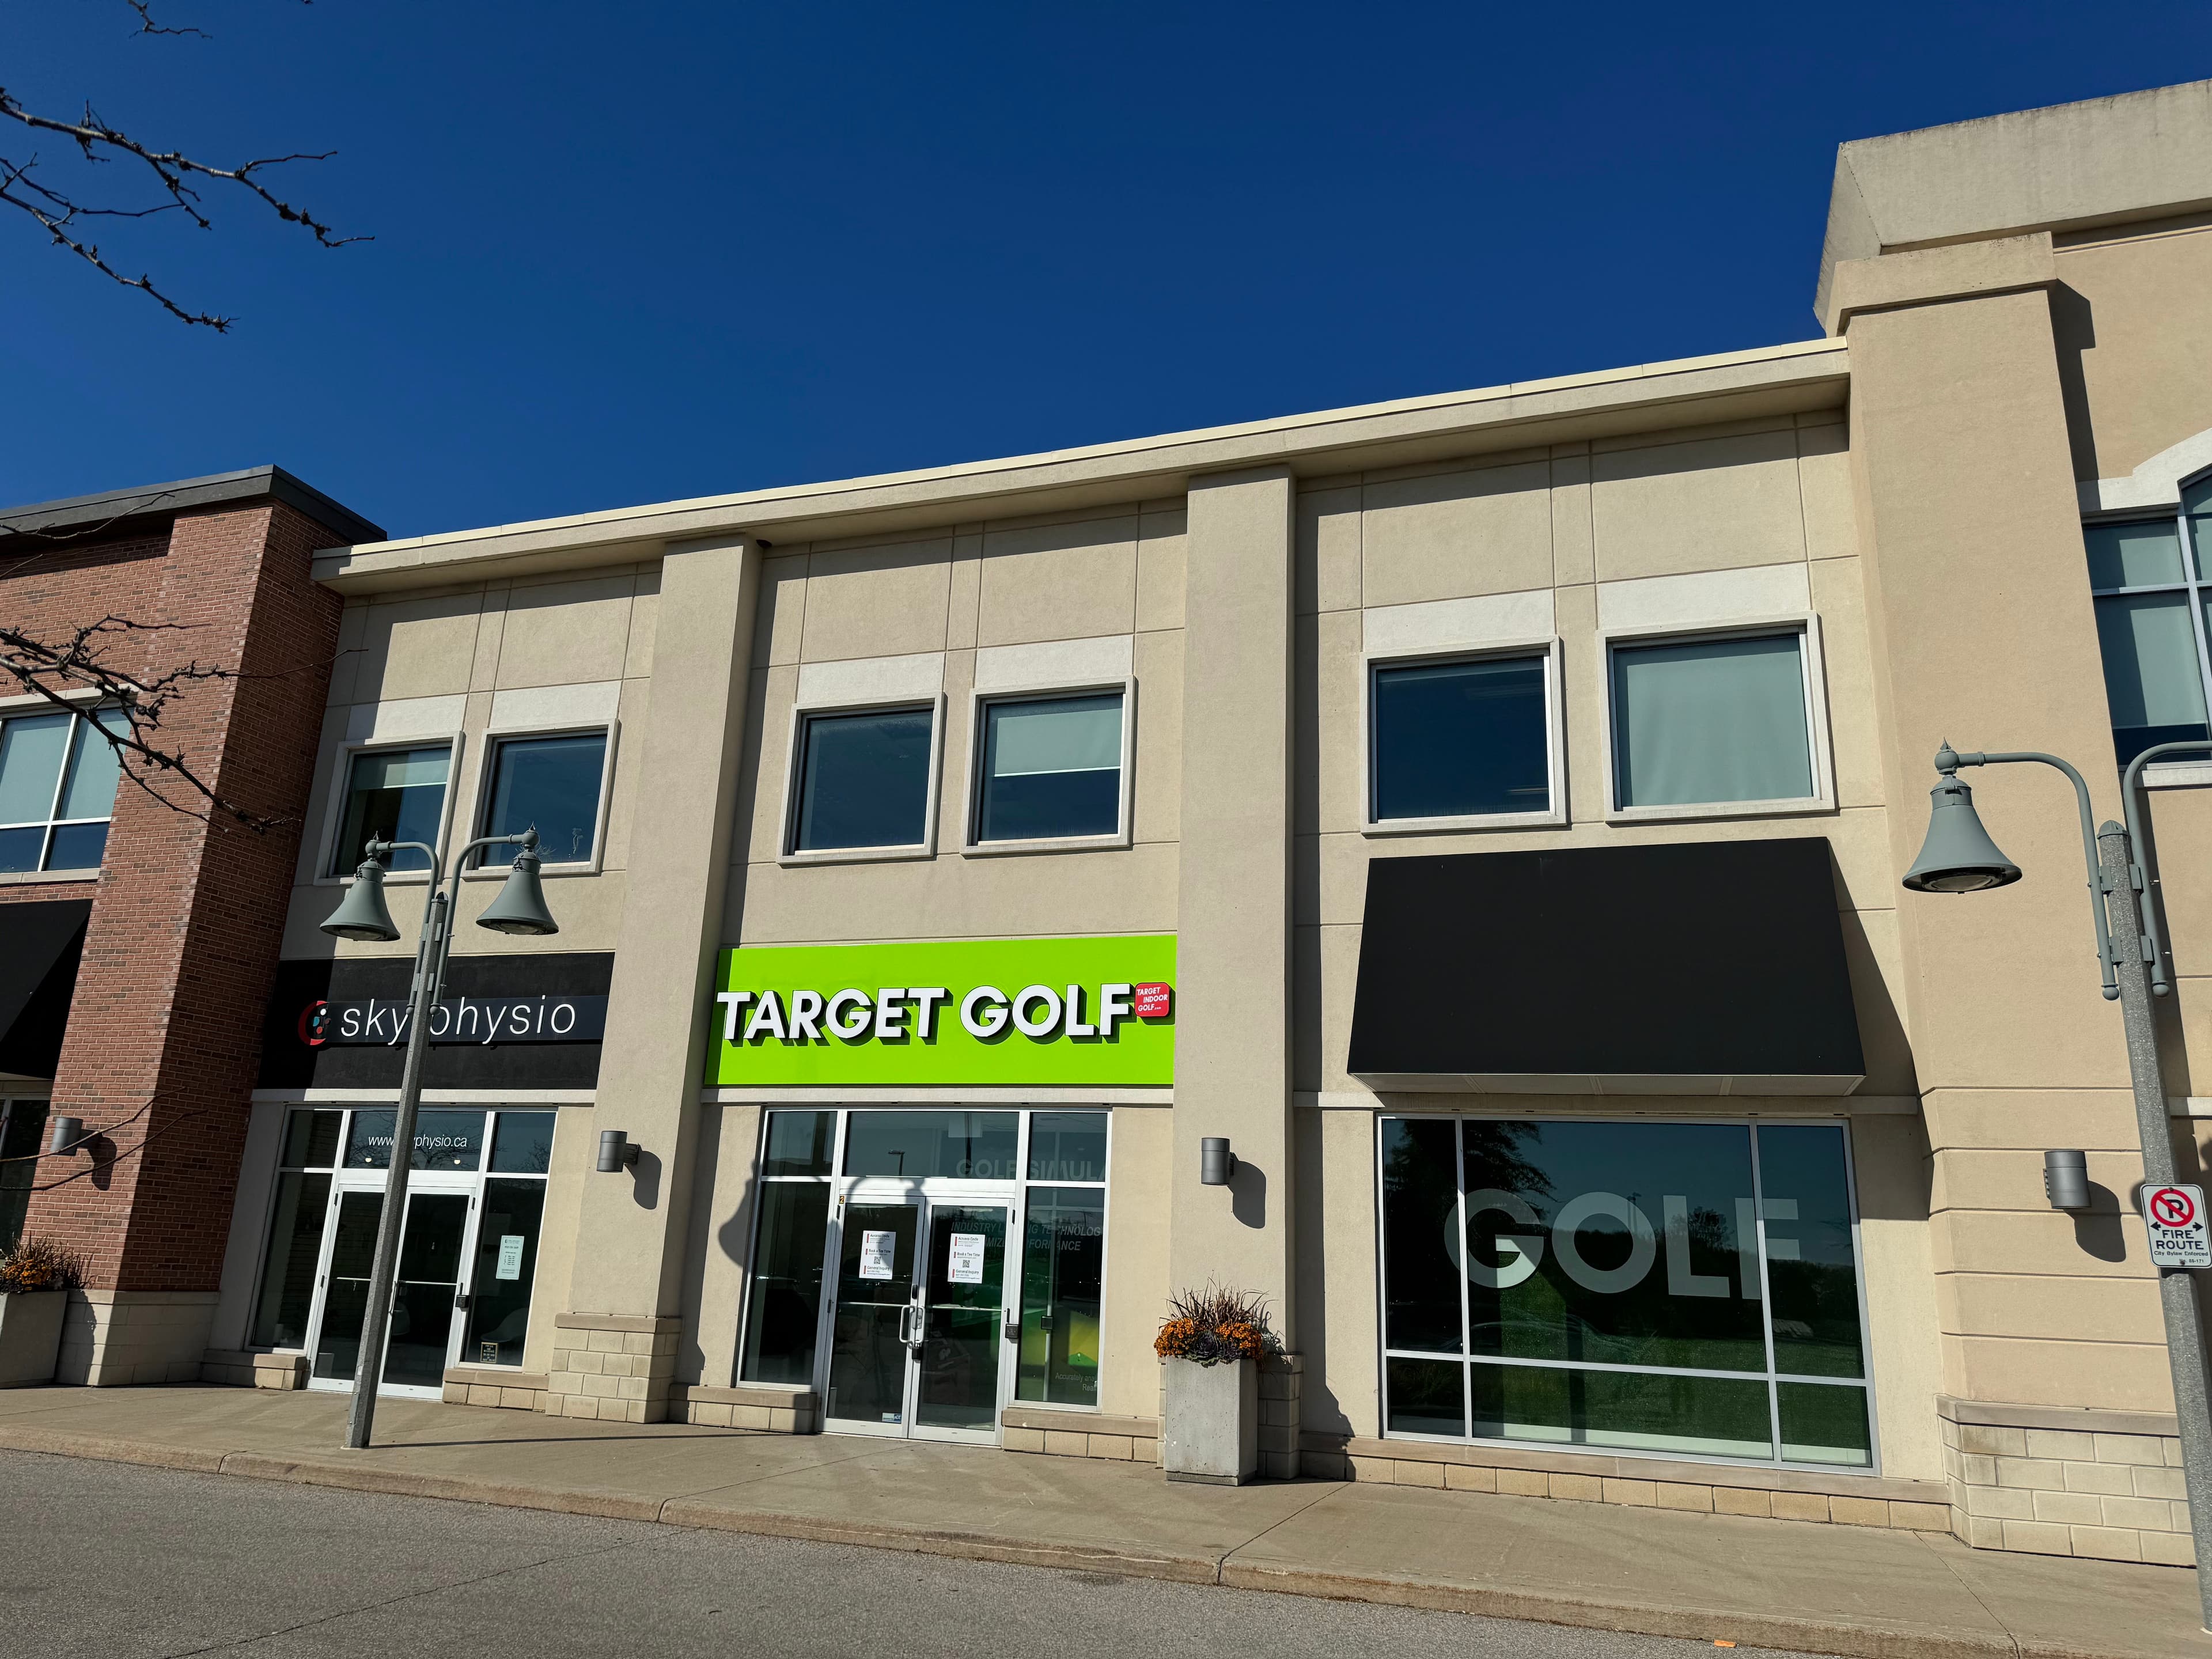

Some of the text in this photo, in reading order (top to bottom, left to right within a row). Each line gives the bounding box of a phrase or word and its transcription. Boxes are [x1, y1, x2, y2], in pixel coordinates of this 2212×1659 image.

[1137, 987, 1161, 995] TARGET
[1143, 994, 1168, 1003] INDOOR
[717, 983, 1131, 1040] TARGET GOLF
[951, 1222, 996, 1233] INDUSTRY
[2162, 1230, 2194, 1239] FIRE
[1444, 1188, 1800, 1300] GOLF
[2156, 1240, 2204, 1249] ROUTE
[1055, 1373, 1083, 1382] Accurately
